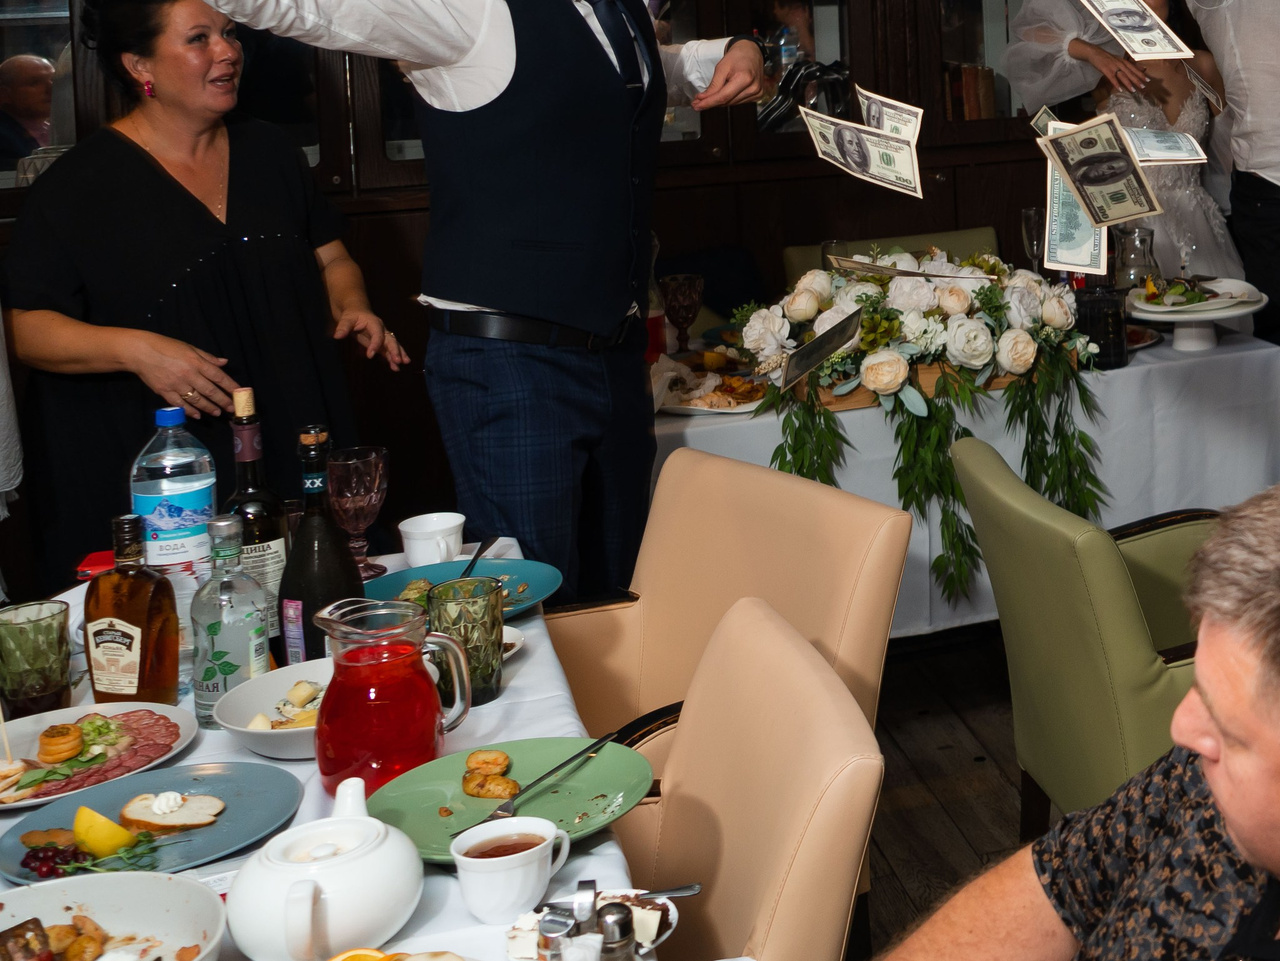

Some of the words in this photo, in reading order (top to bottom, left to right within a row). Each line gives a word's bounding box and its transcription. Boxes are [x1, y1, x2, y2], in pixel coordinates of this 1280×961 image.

[894, 175, 912, 185] 100
[1097, 205, 1110, 220] 100
[1051, 204, 1059, 235] DOLLARS
[304, 477, 323, 489] XX
[159, 543, 186, 552] ВОДА
[194, 680, 220, 693] НАЯ
